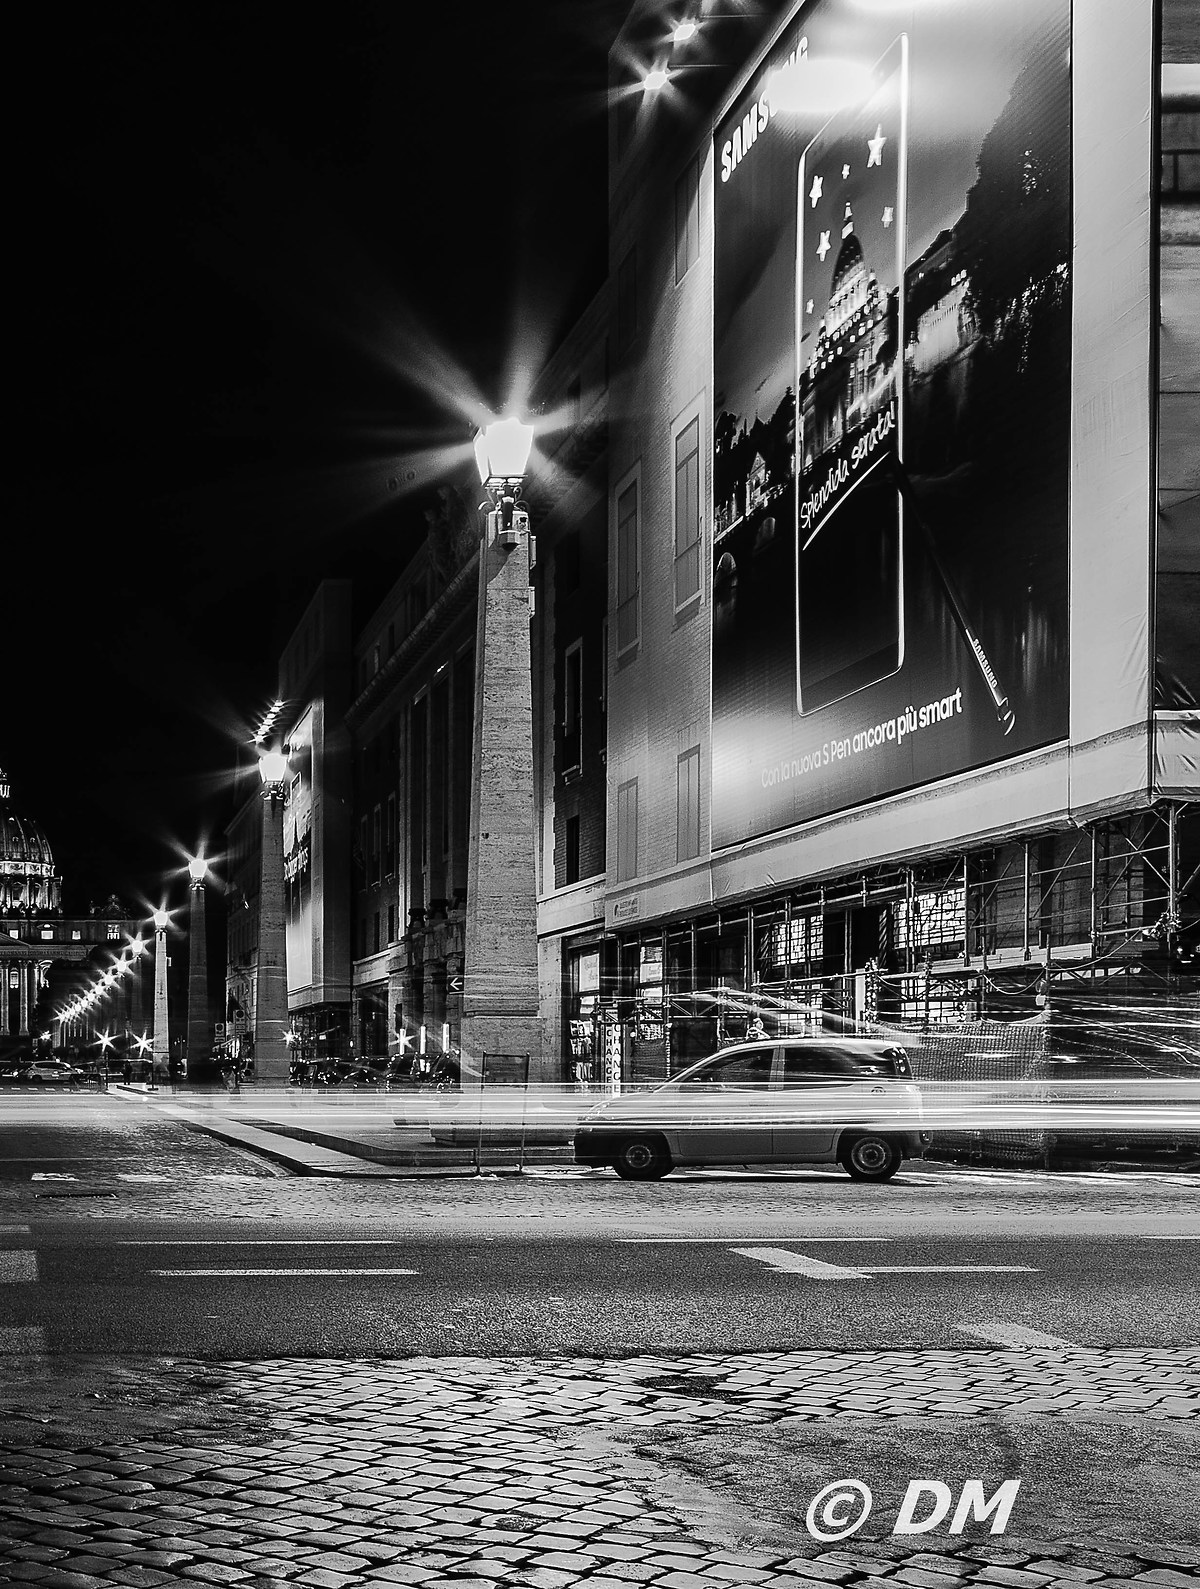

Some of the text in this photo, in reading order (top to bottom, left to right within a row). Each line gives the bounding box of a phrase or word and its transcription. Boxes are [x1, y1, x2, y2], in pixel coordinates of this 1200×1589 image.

[800, 458, 850, 528] Splendida
[973, 638, 998, 688] SAMSUNG
[761, 687, 963, 788] Con la nuova S Pen ancora più smart
